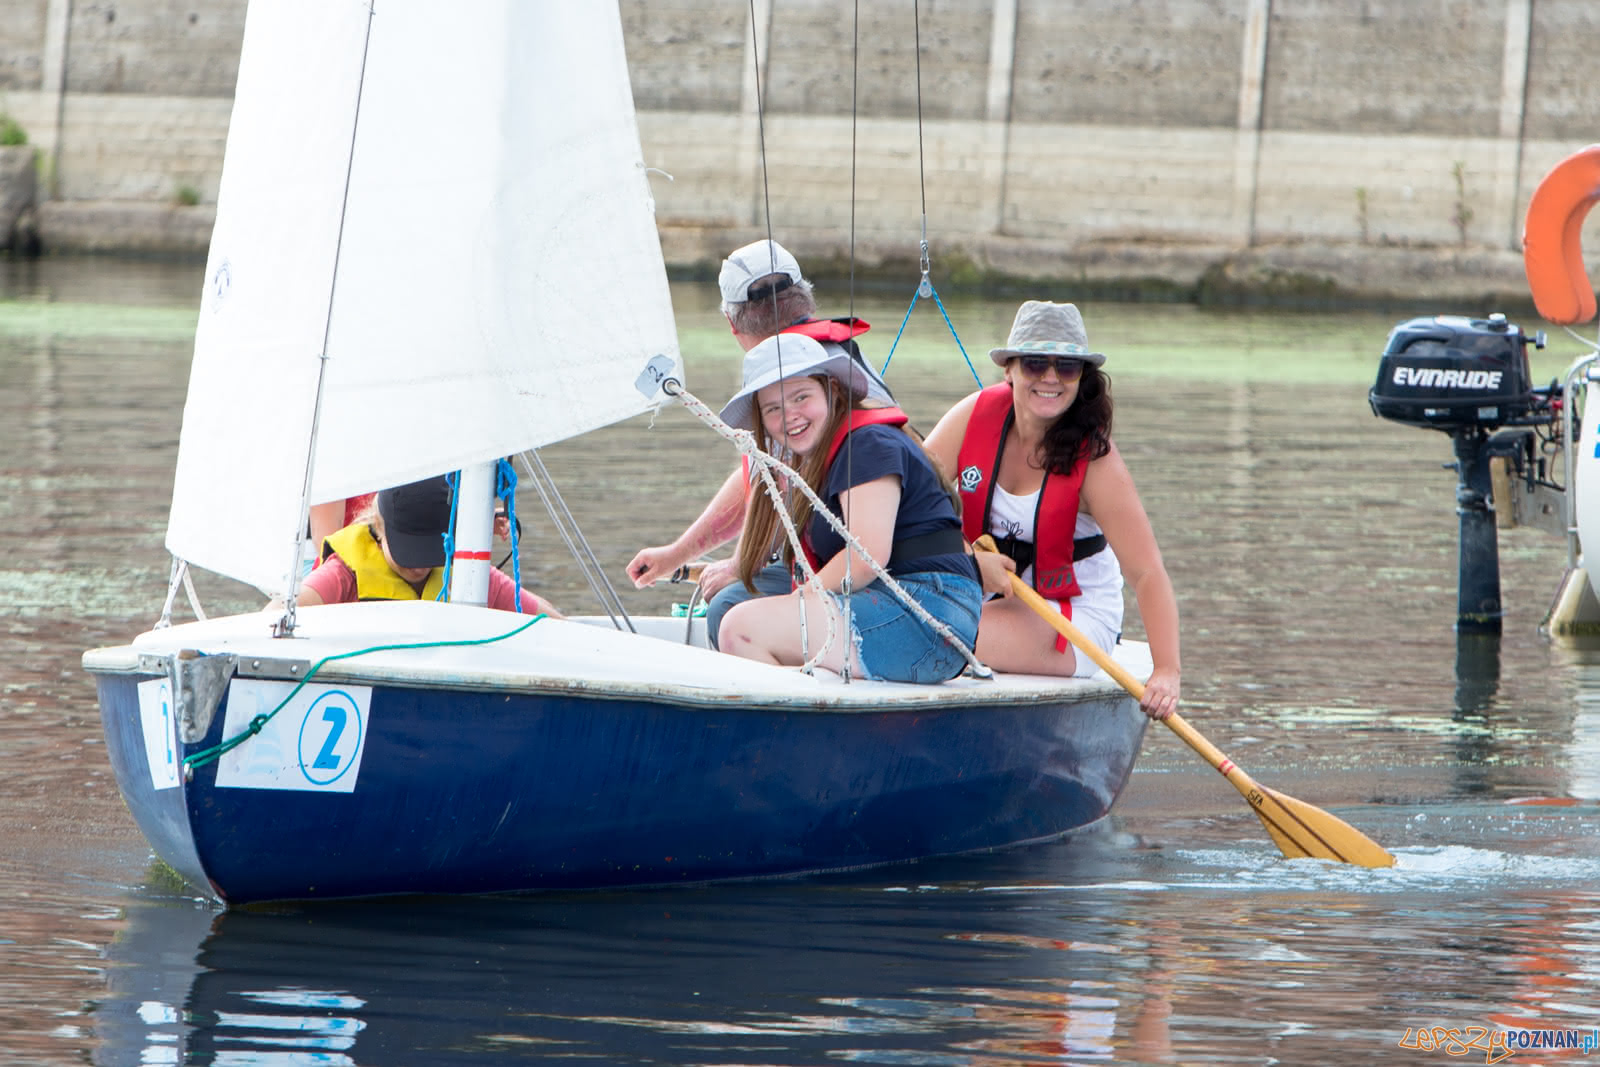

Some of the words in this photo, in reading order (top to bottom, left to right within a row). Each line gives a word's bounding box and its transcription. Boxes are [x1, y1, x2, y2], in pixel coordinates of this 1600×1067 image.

[648, 366, 664, 383] 2
[1393, 366, 1503, 389] EVINRUDE
[313, 707, 347, 769] 2
